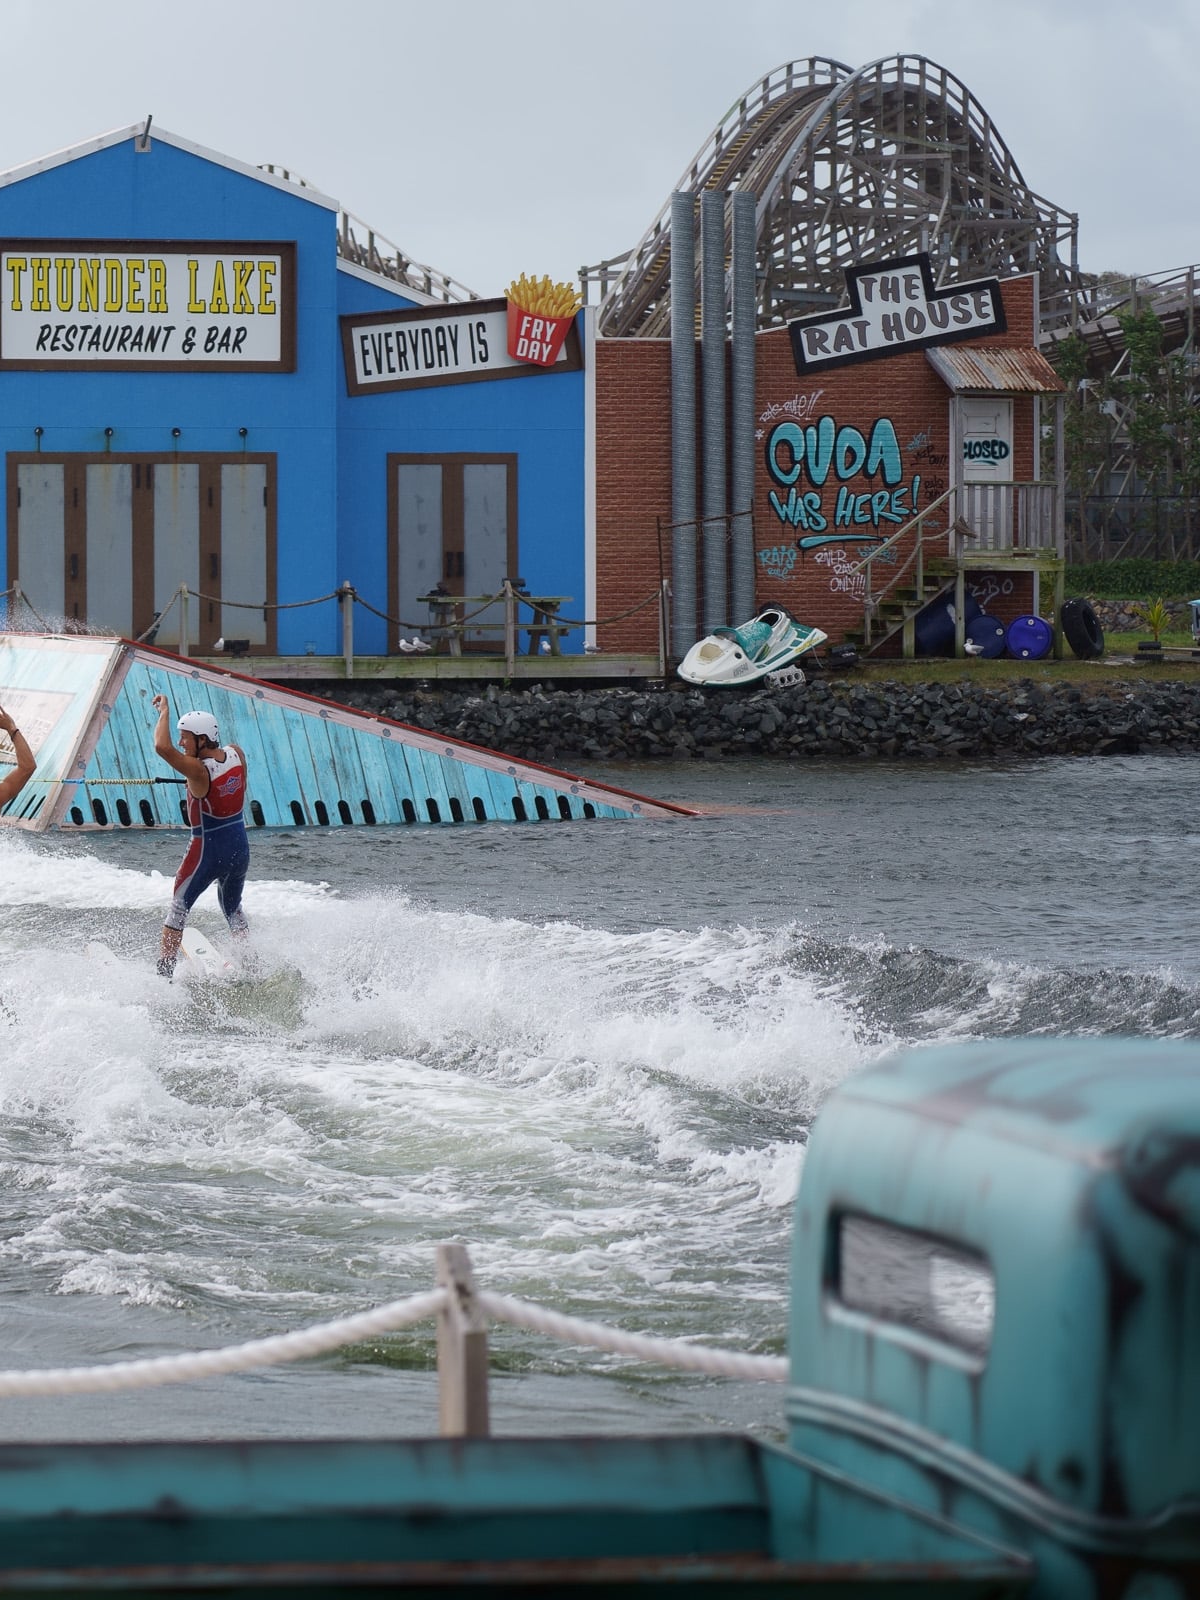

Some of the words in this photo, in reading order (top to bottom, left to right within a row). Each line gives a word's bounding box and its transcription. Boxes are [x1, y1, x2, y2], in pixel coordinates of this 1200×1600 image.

[6, 257, 168, 313] THUNDER
[187, 260, 277, 315] LAKE
[858, 273, 921, 304] THE
[35, 323, 176, 353] RESTAURANT
[181, 325, 197, 354] &
[203, 325, 248, 354] BAR
[520, 316, 557, 342] FRY
[802, 320, 871, 356] RAT
[881, 290, 991, 341] HOUSE
[360, 324, 459, 377] EVERYDAY
[468, 321, 489, 364] IS
[516, 338, 553, 362] DAY
[768, 487, 828, 532] WAS
[833, 474, 921, 529] HERE!
